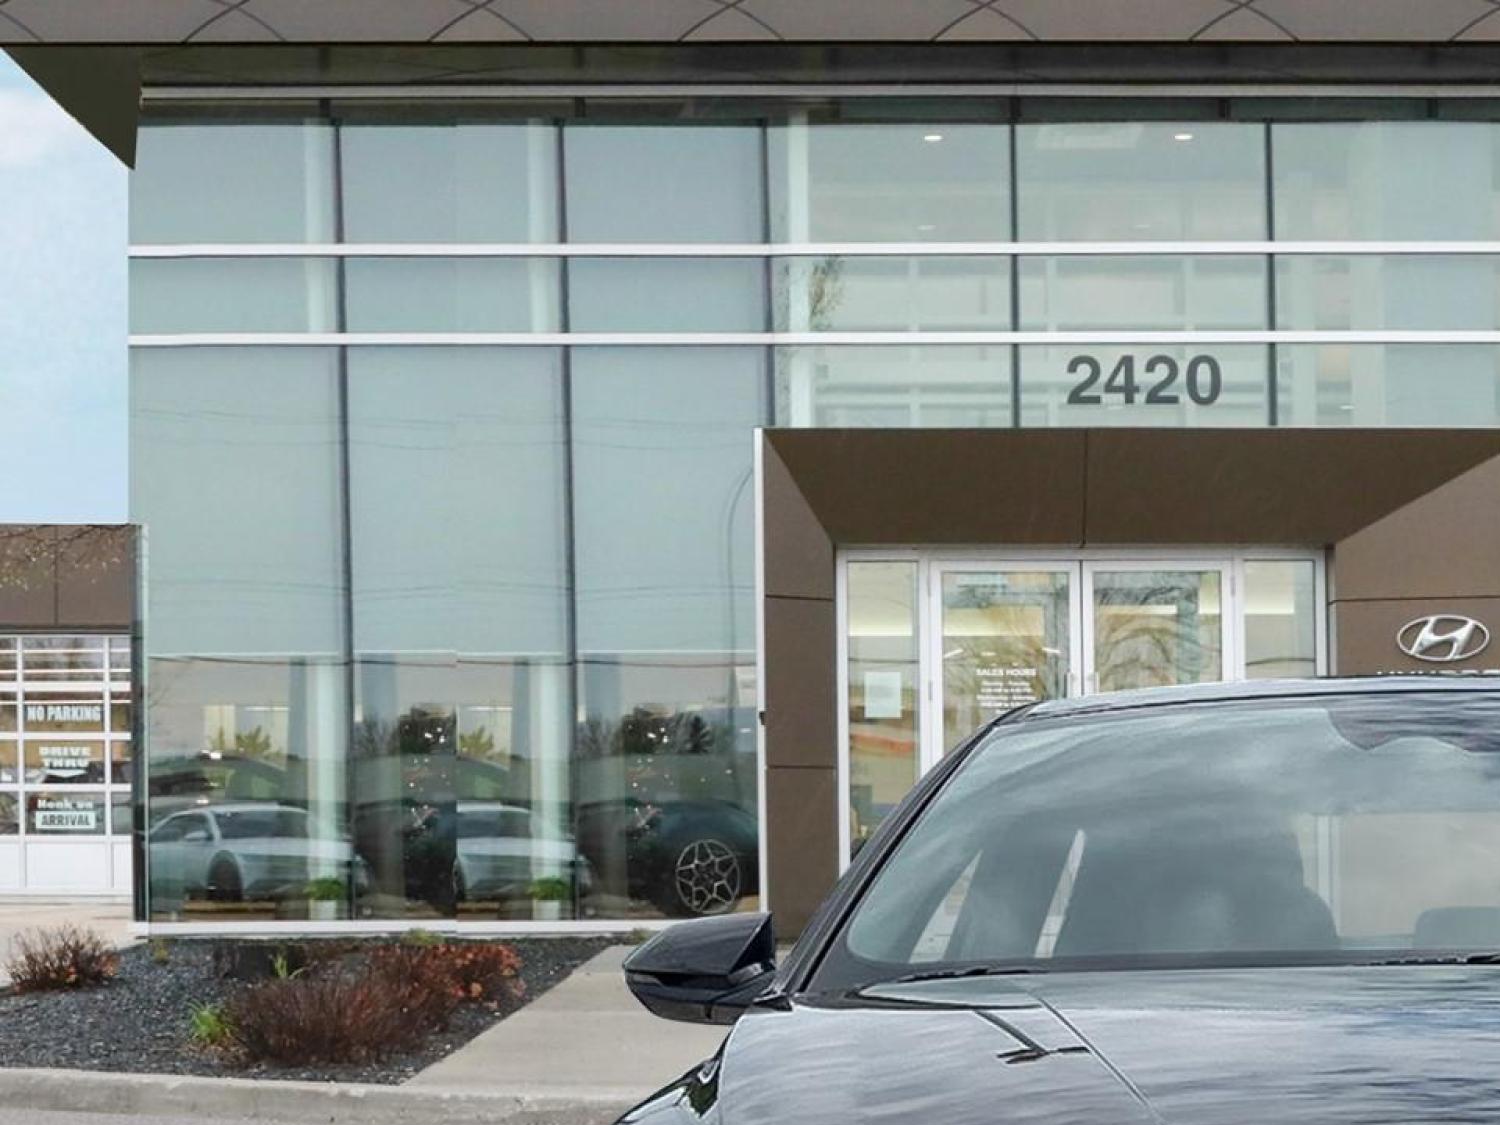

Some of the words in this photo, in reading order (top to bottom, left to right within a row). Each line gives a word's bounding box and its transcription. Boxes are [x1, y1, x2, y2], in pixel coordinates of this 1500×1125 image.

[1066, 354, 1222, 405] 2420
[27, 705, 45, 721] NO
[47, 705, 101, 721] PARKING
[41, 814, 91, 826] ARRIVAL
